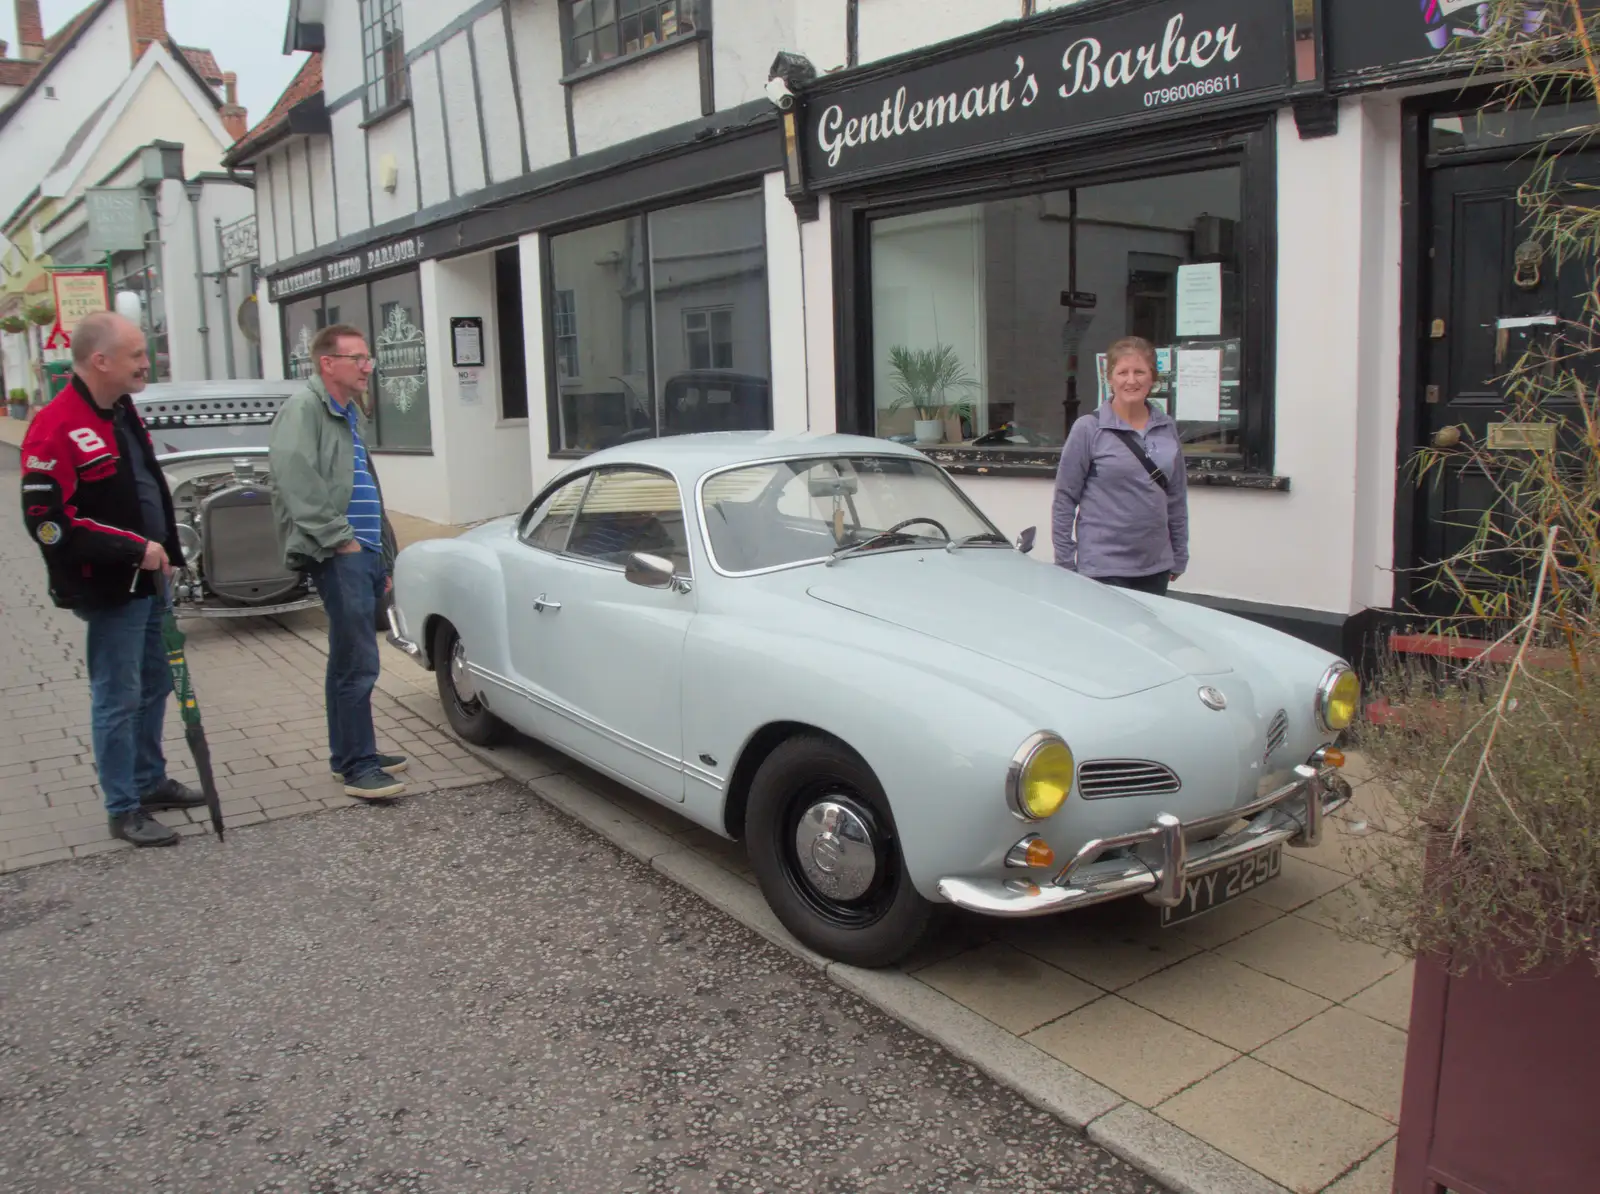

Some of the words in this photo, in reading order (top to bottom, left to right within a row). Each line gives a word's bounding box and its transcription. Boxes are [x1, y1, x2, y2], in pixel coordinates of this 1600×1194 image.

[818, 55, 1039, 167] Gentleman's
[1059, 13, 1241, 98] Barber
[1143, 74, 1241, 107] 07960066611
[327, 256, 361, 281] TATTOO
[367, 238, 416, 270] PARLOUR
[458, 371, 469, 379] NO
[68, 427, 107, 453] 8
